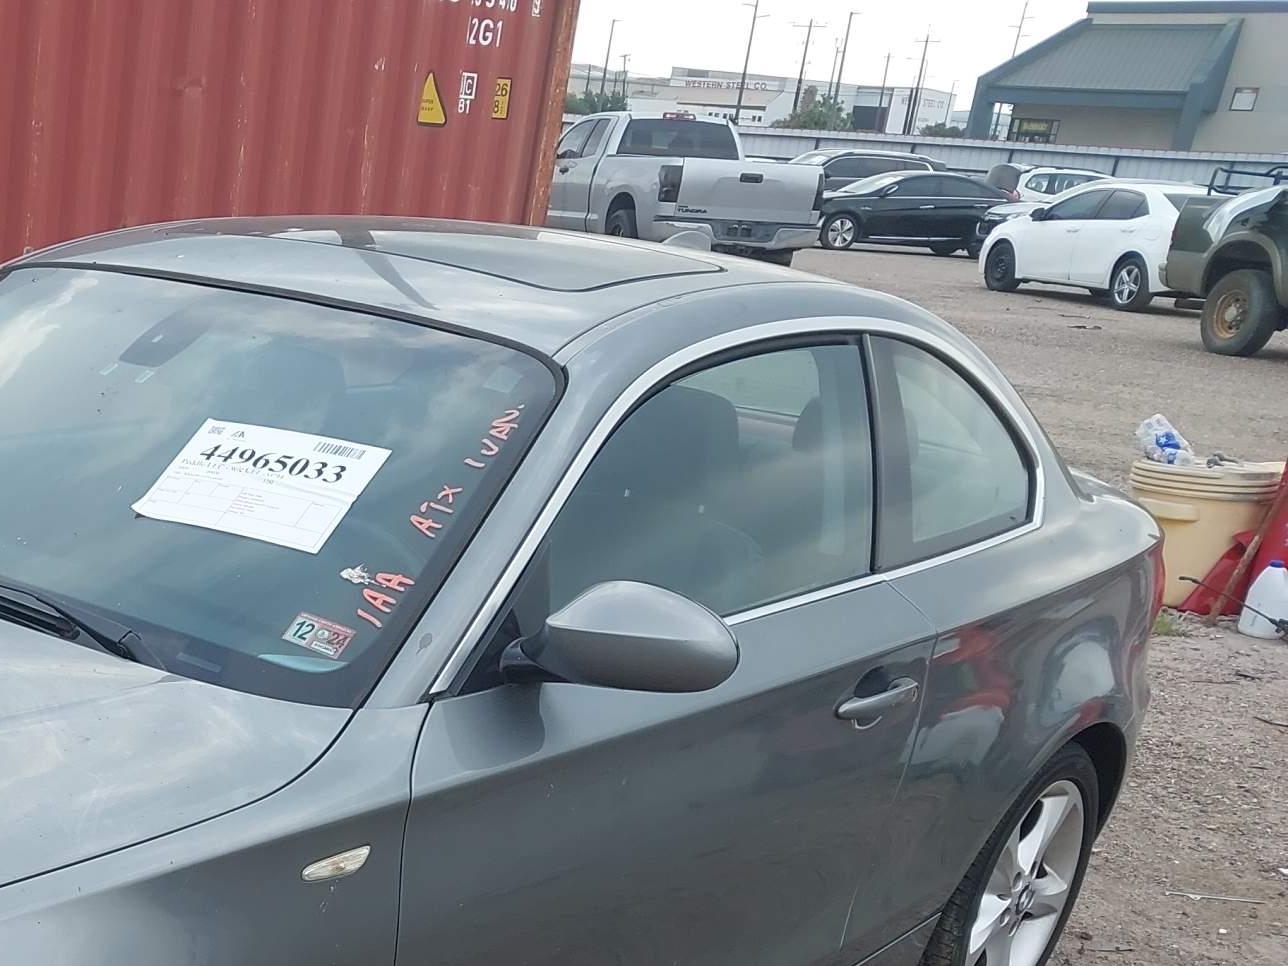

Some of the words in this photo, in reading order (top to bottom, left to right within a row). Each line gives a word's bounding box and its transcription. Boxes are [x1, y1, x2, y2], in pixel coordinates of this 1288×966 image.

[466, 16, 503, 48] 2G1
[685, 79, 723, 89] WESTERN
[726, 80, 750, 91] STEL
[200, 443, 347, 484] 44965033
[356, 571, 415, 628] IAA
[292, 620, 316, 641] 12
